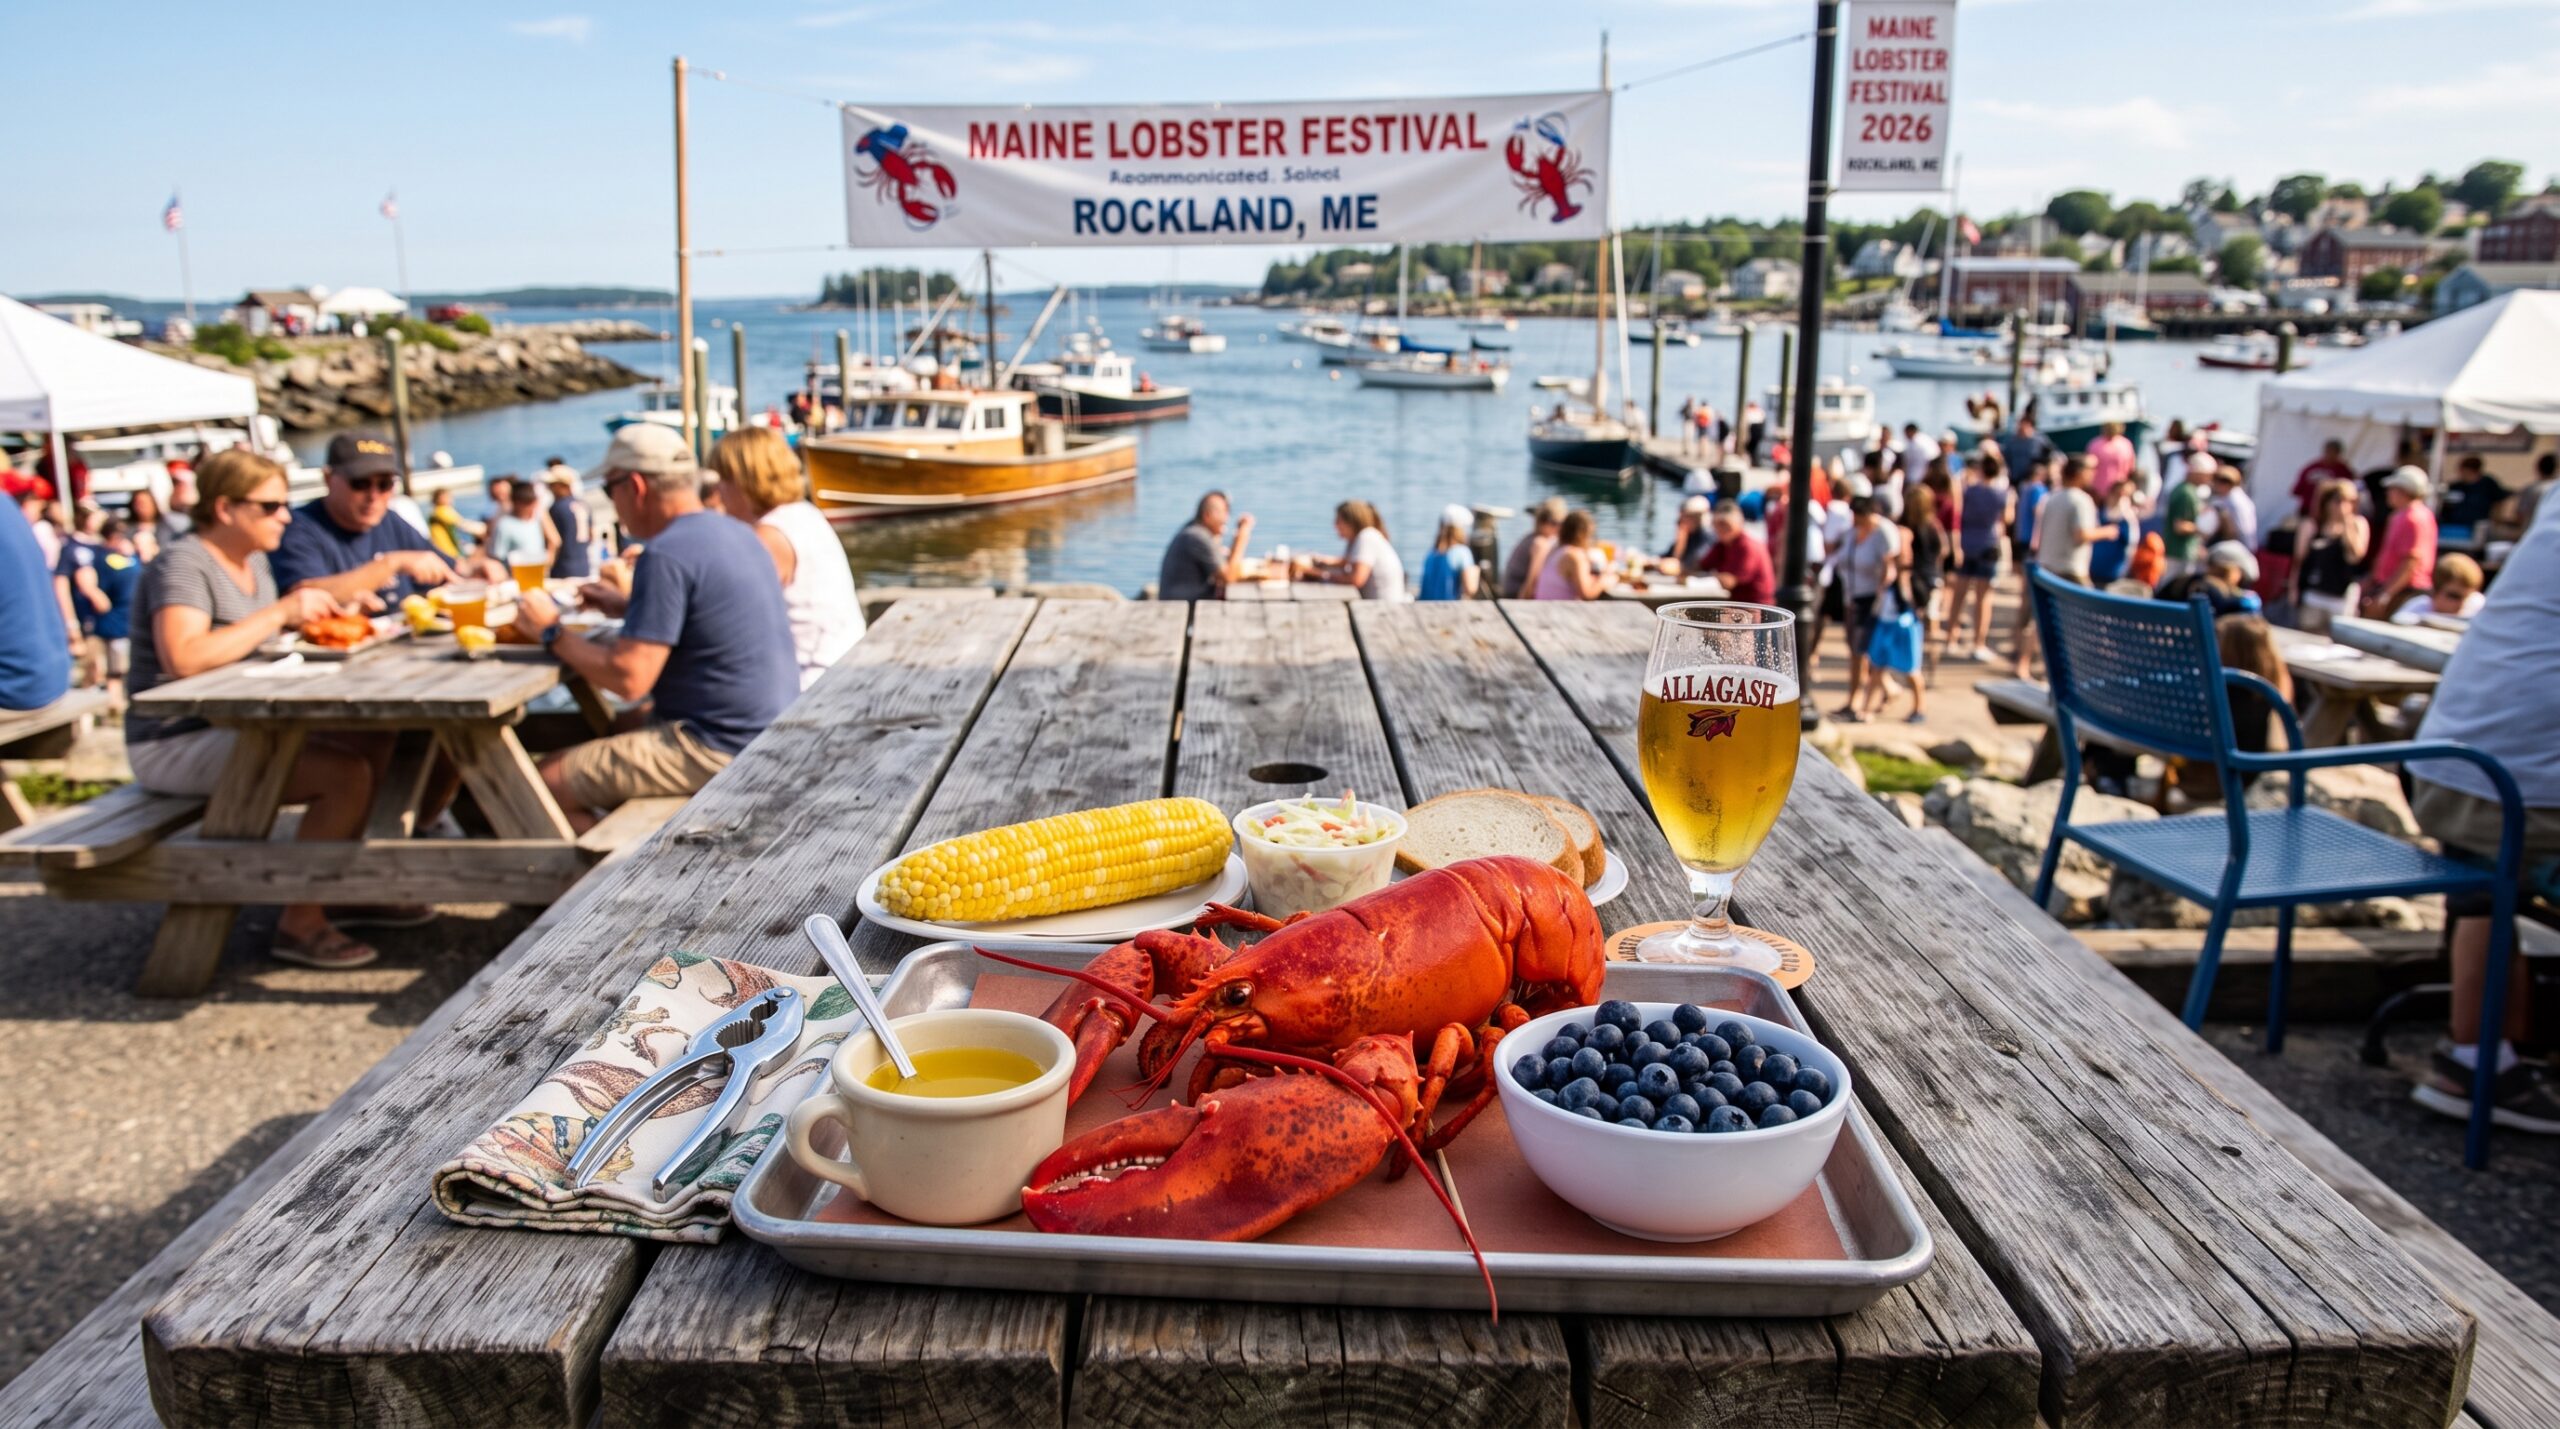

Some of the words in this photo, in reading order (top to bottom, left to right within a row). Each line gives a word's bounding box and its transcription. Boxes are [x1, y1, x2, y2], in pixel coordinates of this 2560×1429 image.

[1867, 16, 1936, 40] MAINE
[1852, 48, 1948, 73] LOBSTER
[1849, 79, 1946, 105] FESTIVAL
[967, 121, 1094, 160] MAINE
[1107, 117, 1288, 160] LOBSTER
[1300, 112, 1488, 156] FESTIVAL
[1860, 113, 1933, 143] 2026
[1073, 197, 1307, 240] ROCKLAND,
[1321, 193, 1379, 231] ME
[1660, 675, 1778, 710] ALLAGASH
